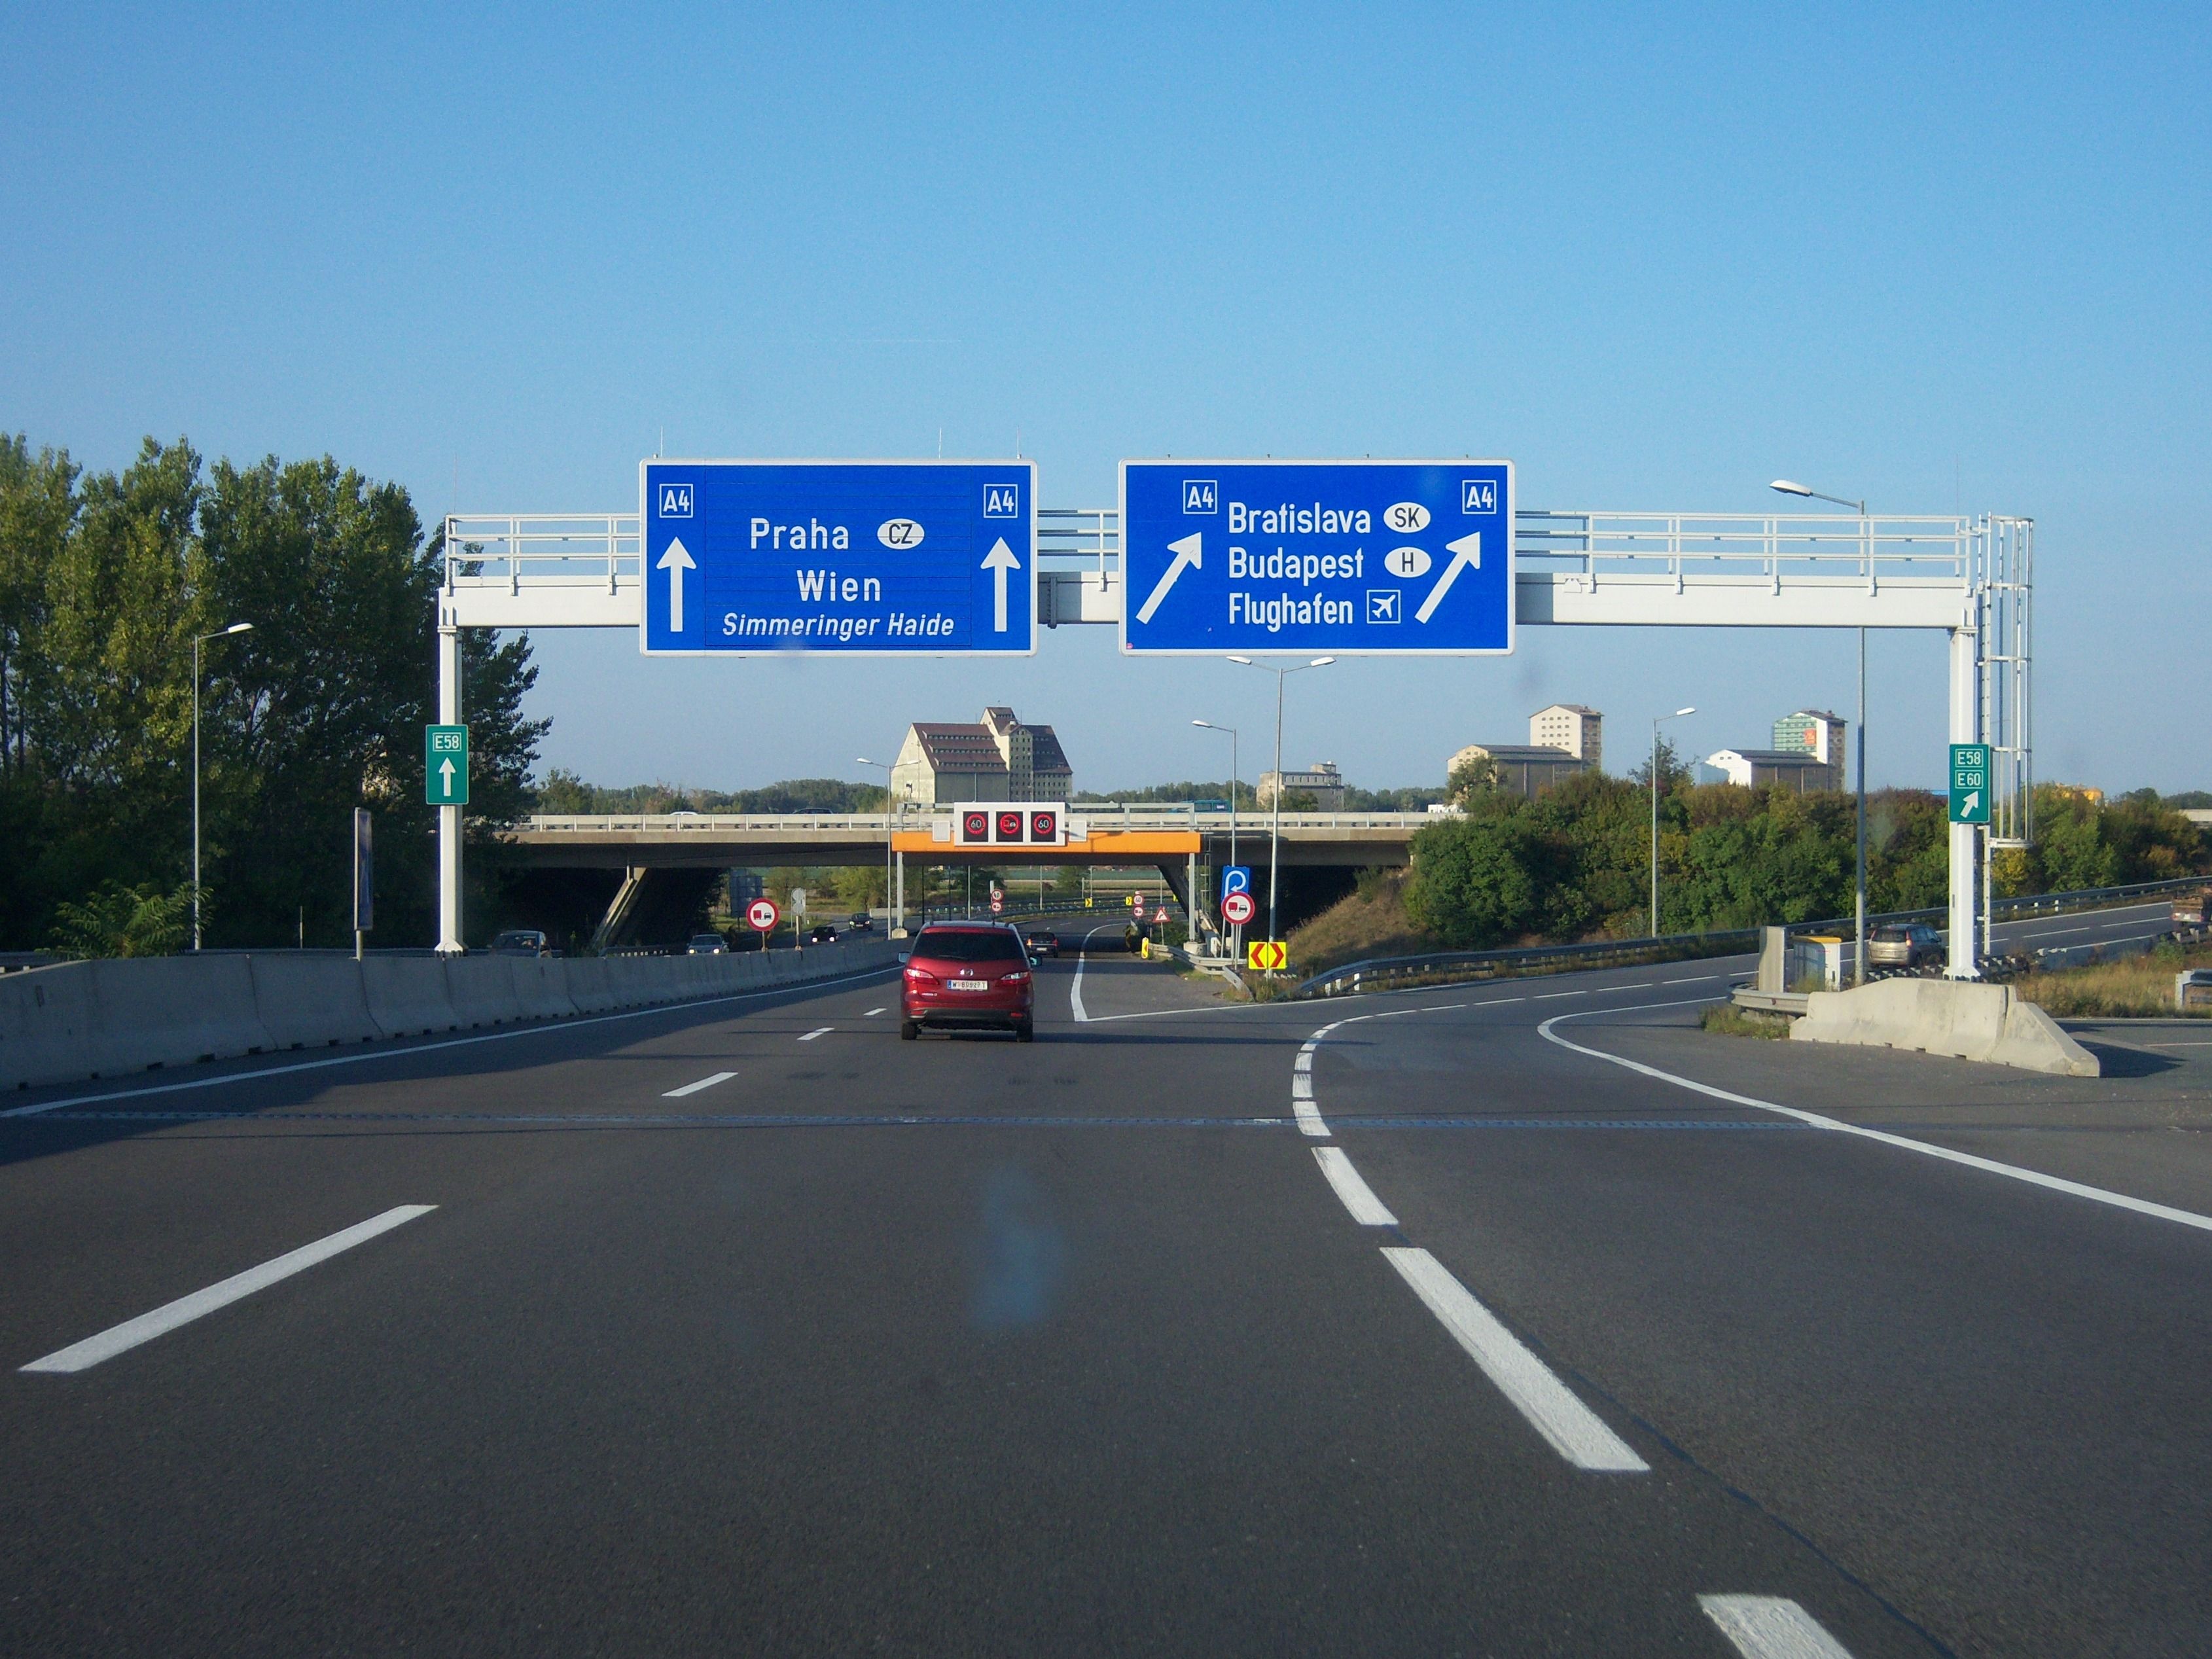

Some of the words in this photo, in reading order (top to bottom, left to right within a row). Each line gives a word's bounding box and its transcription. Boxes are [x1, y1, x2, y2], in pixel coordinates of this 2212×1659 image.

[663, 490, 689, 512] A4
[988, 490, 1014, 512] A4
[1187, 486, 1214, 508] A4
[1467, 486, 1493, 508] A4
[1228, 502, 1370, 533] Bratislava
[1394, 507, 1420, 528] SK
[751, 518, 849, 550] Praha
[888, 523, 914, 545] CZ
[1229, 546, 1364, 586] Budapest
[1402, 552, 1414, 573] H
[796, 569, 881, 601] Wien
[1229, 592, 1353, 633] Flughafen
[722, 612, 881, 642] Simmeringer
[887, 613, 955, 636] Haide
[435, 735, 459, 749] E58
[1957, 751, 1981, 765] E58
[1957, 772, 1981, 786] E60
[971, 819, 982, 828] 60
[1038, 819, 1049, 828] 60
